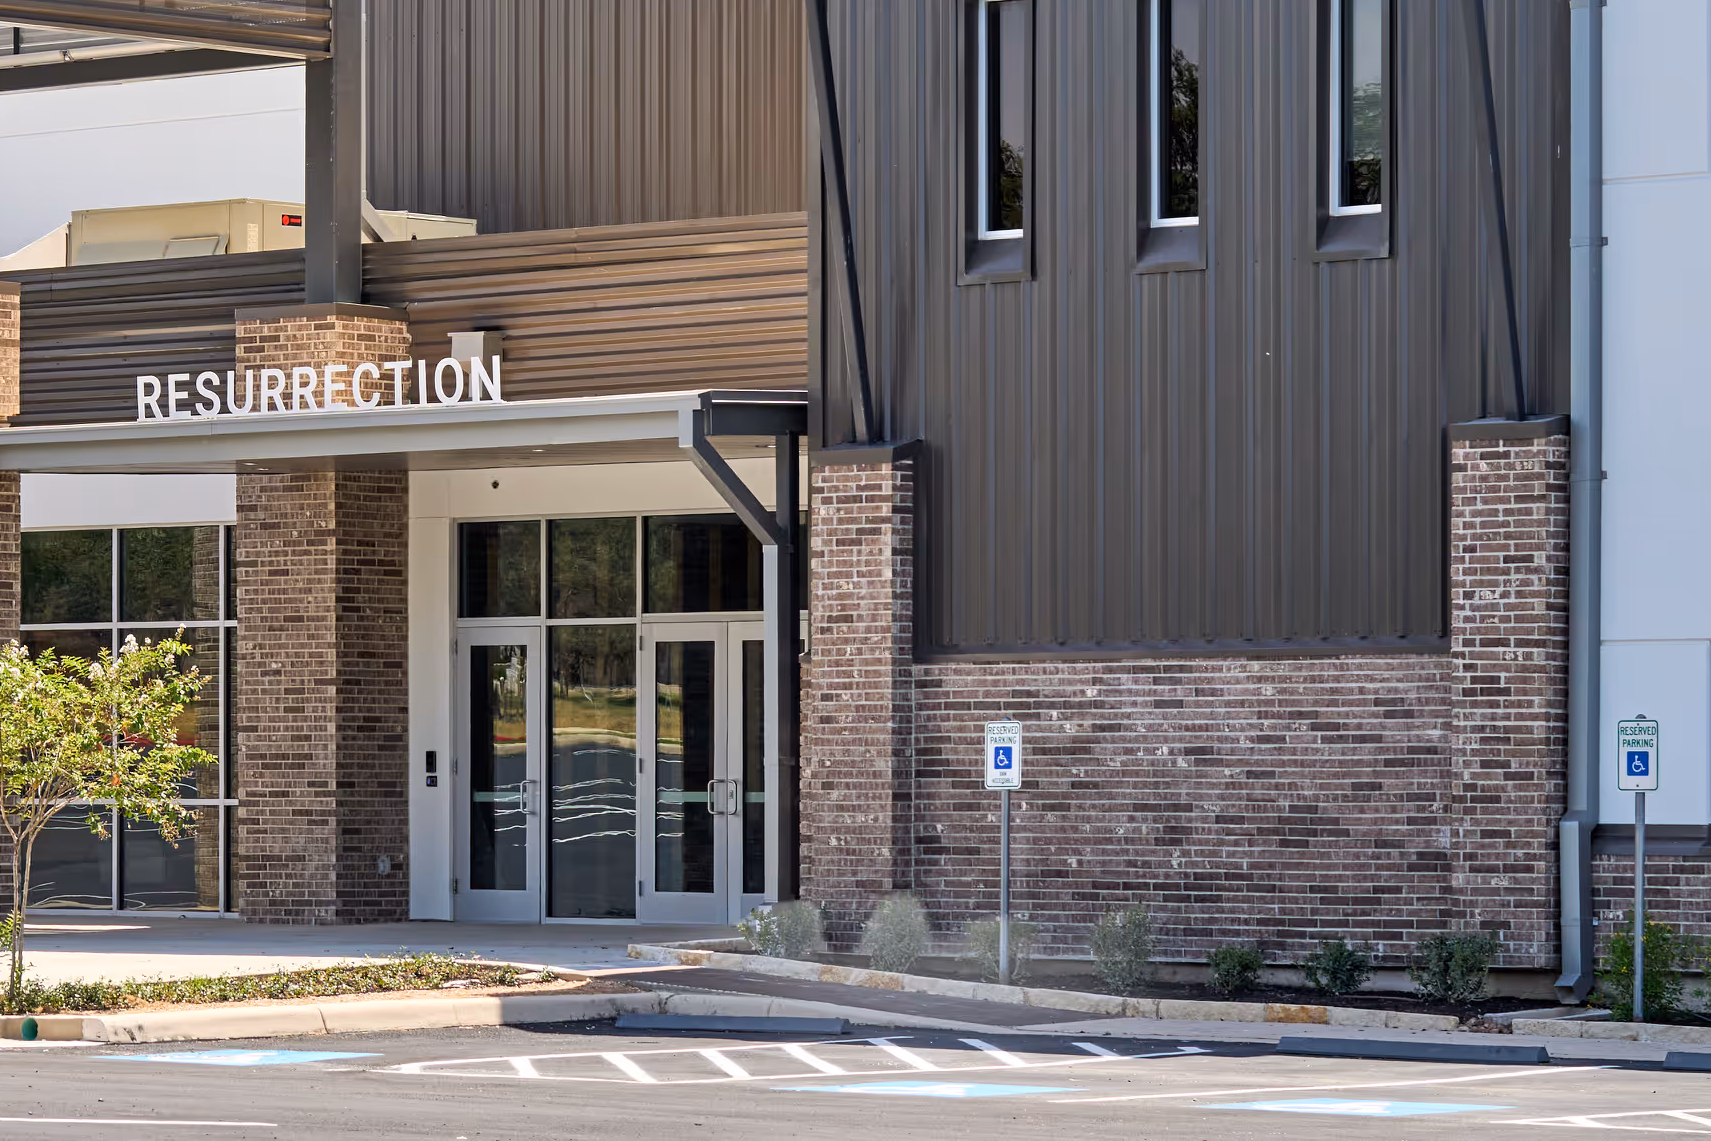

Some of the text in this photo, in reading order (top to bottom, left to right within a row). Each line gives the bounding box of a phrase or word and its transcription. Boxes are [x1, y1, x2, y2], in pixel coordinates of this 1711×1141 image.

[136, 354, 503, 422] RESURRECTION
[988, 726, 1019, 735] RESERVED
[1620, 726, 1657, 736] RESERVED
[990, 736, 1017, 744] PARKING
[1622, 739, 1654, 748] PARKING
